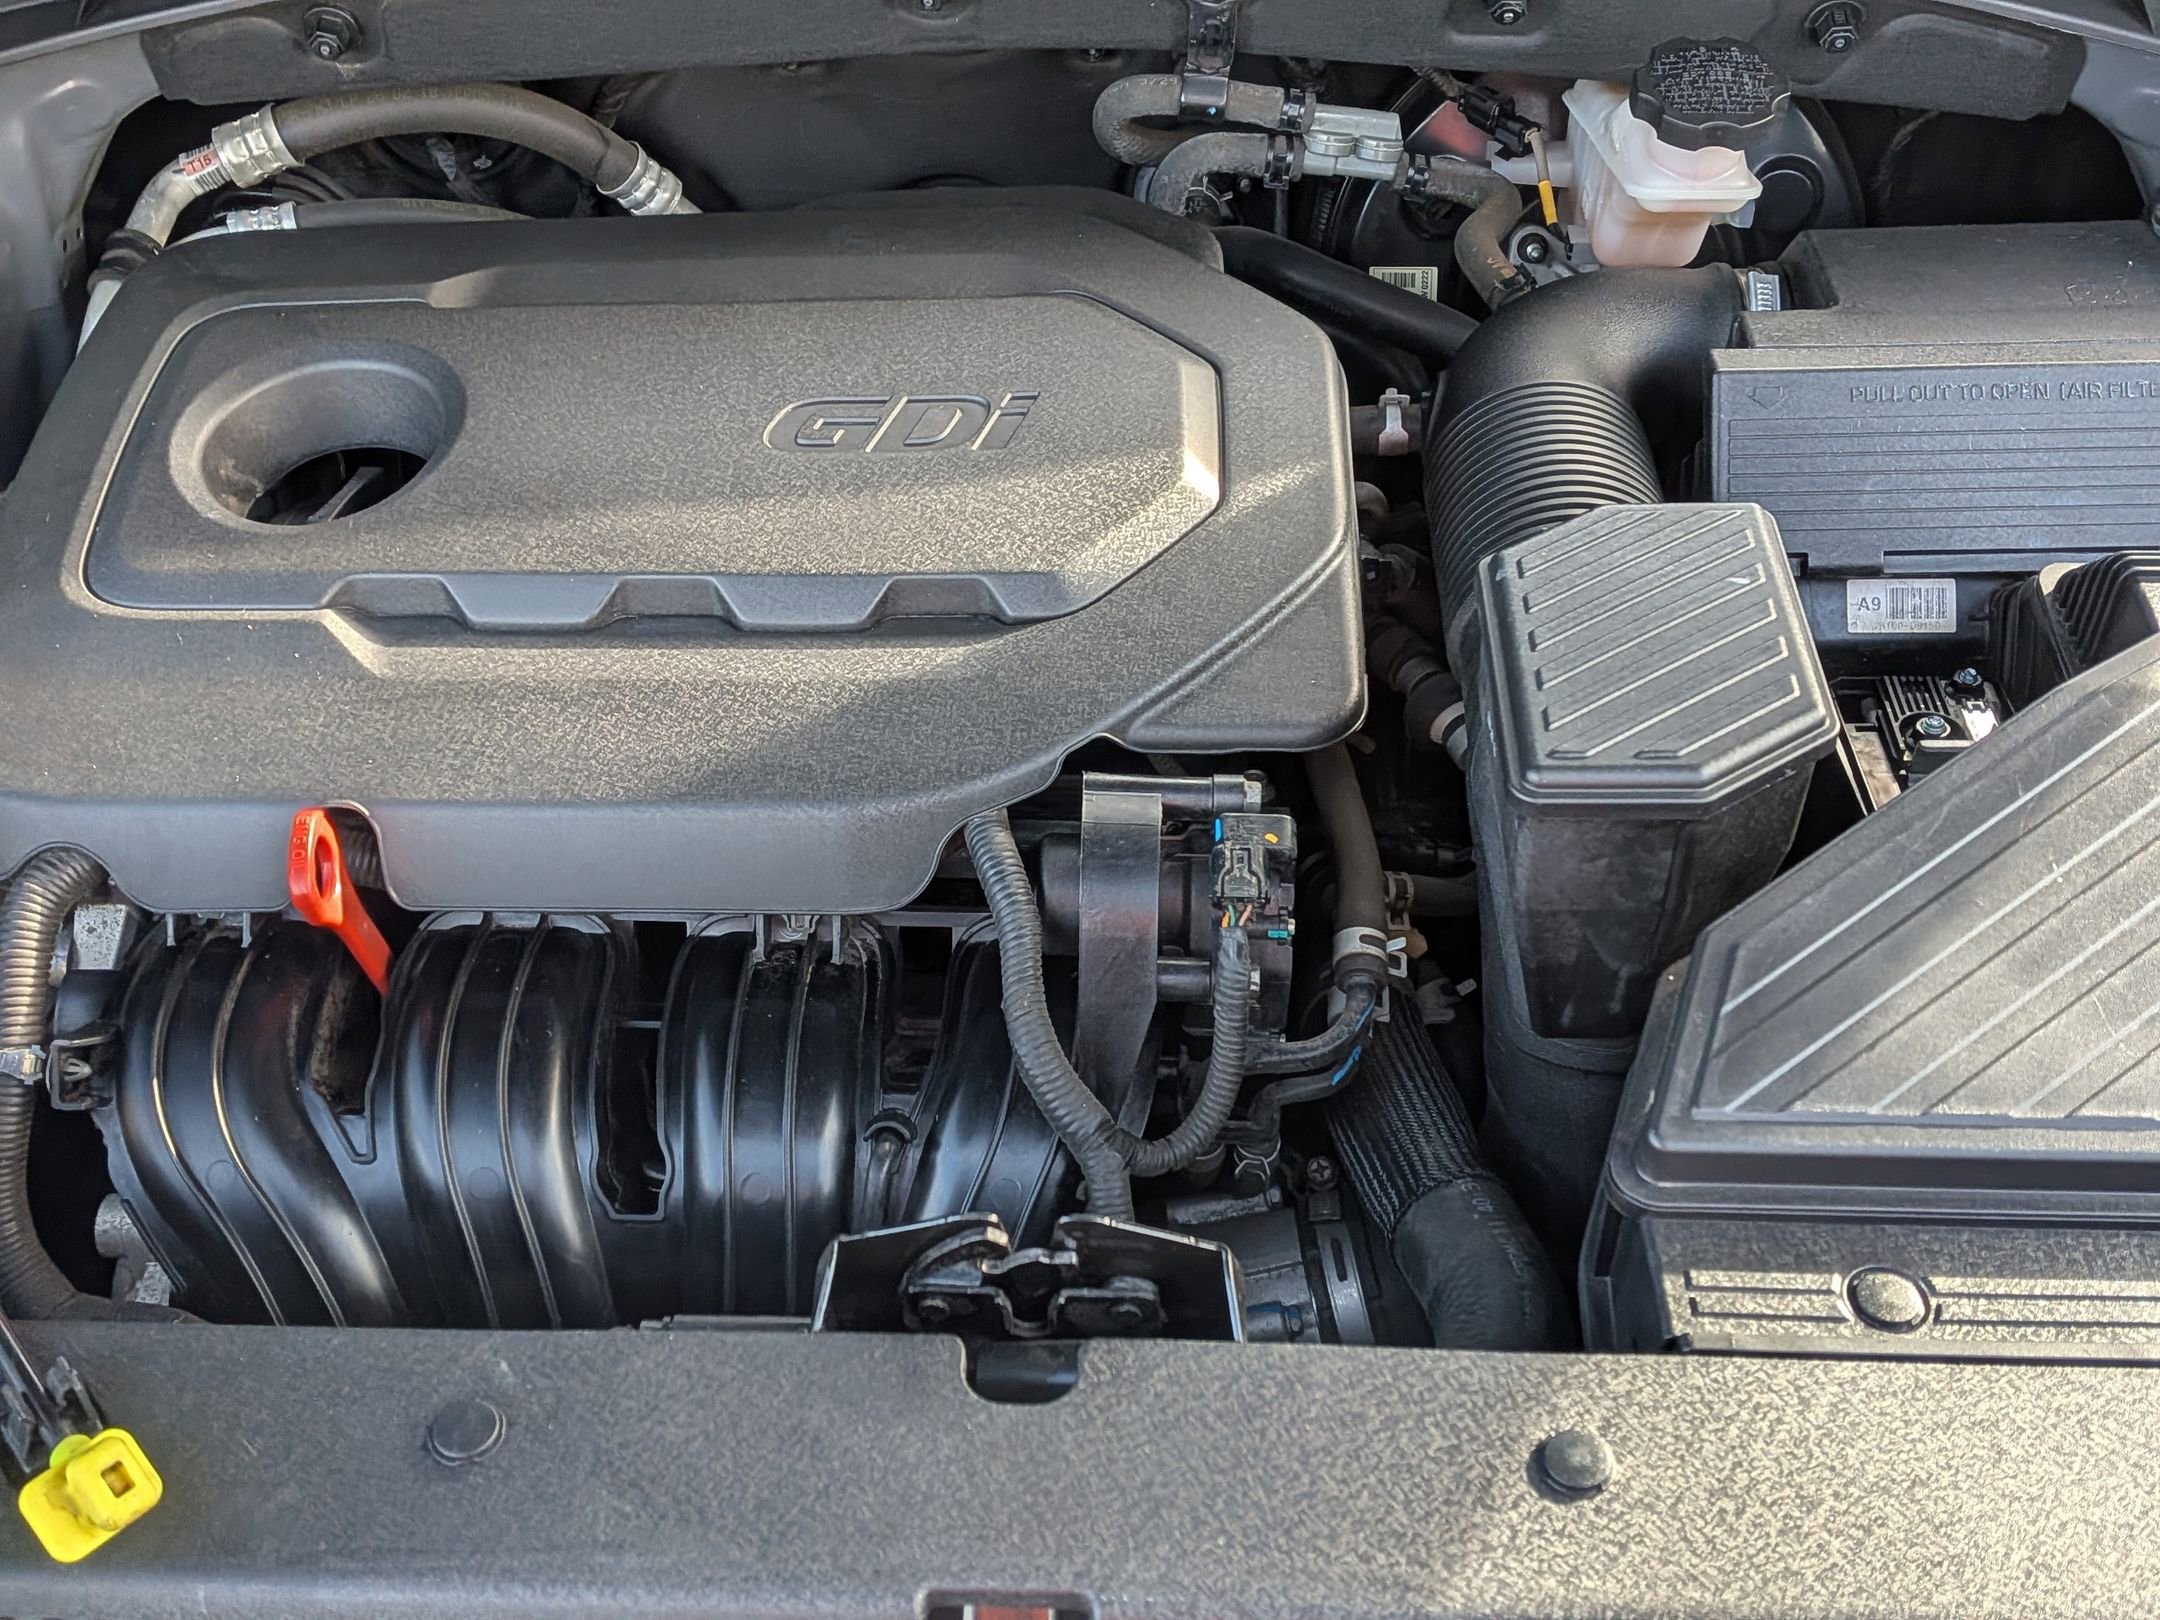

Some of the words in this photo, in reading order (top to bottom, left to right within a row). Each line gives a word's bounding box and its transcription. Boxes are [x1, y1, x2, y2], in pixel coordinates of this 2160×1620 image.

[1850, 383, 1905, 403] PULL
[1909, 382, 1955, 402] OUT
[1957, 382, 1986, 401] TO
[1990, 380, 2050, 401] OPEN
[1857, 596, 1882, 612] A9
